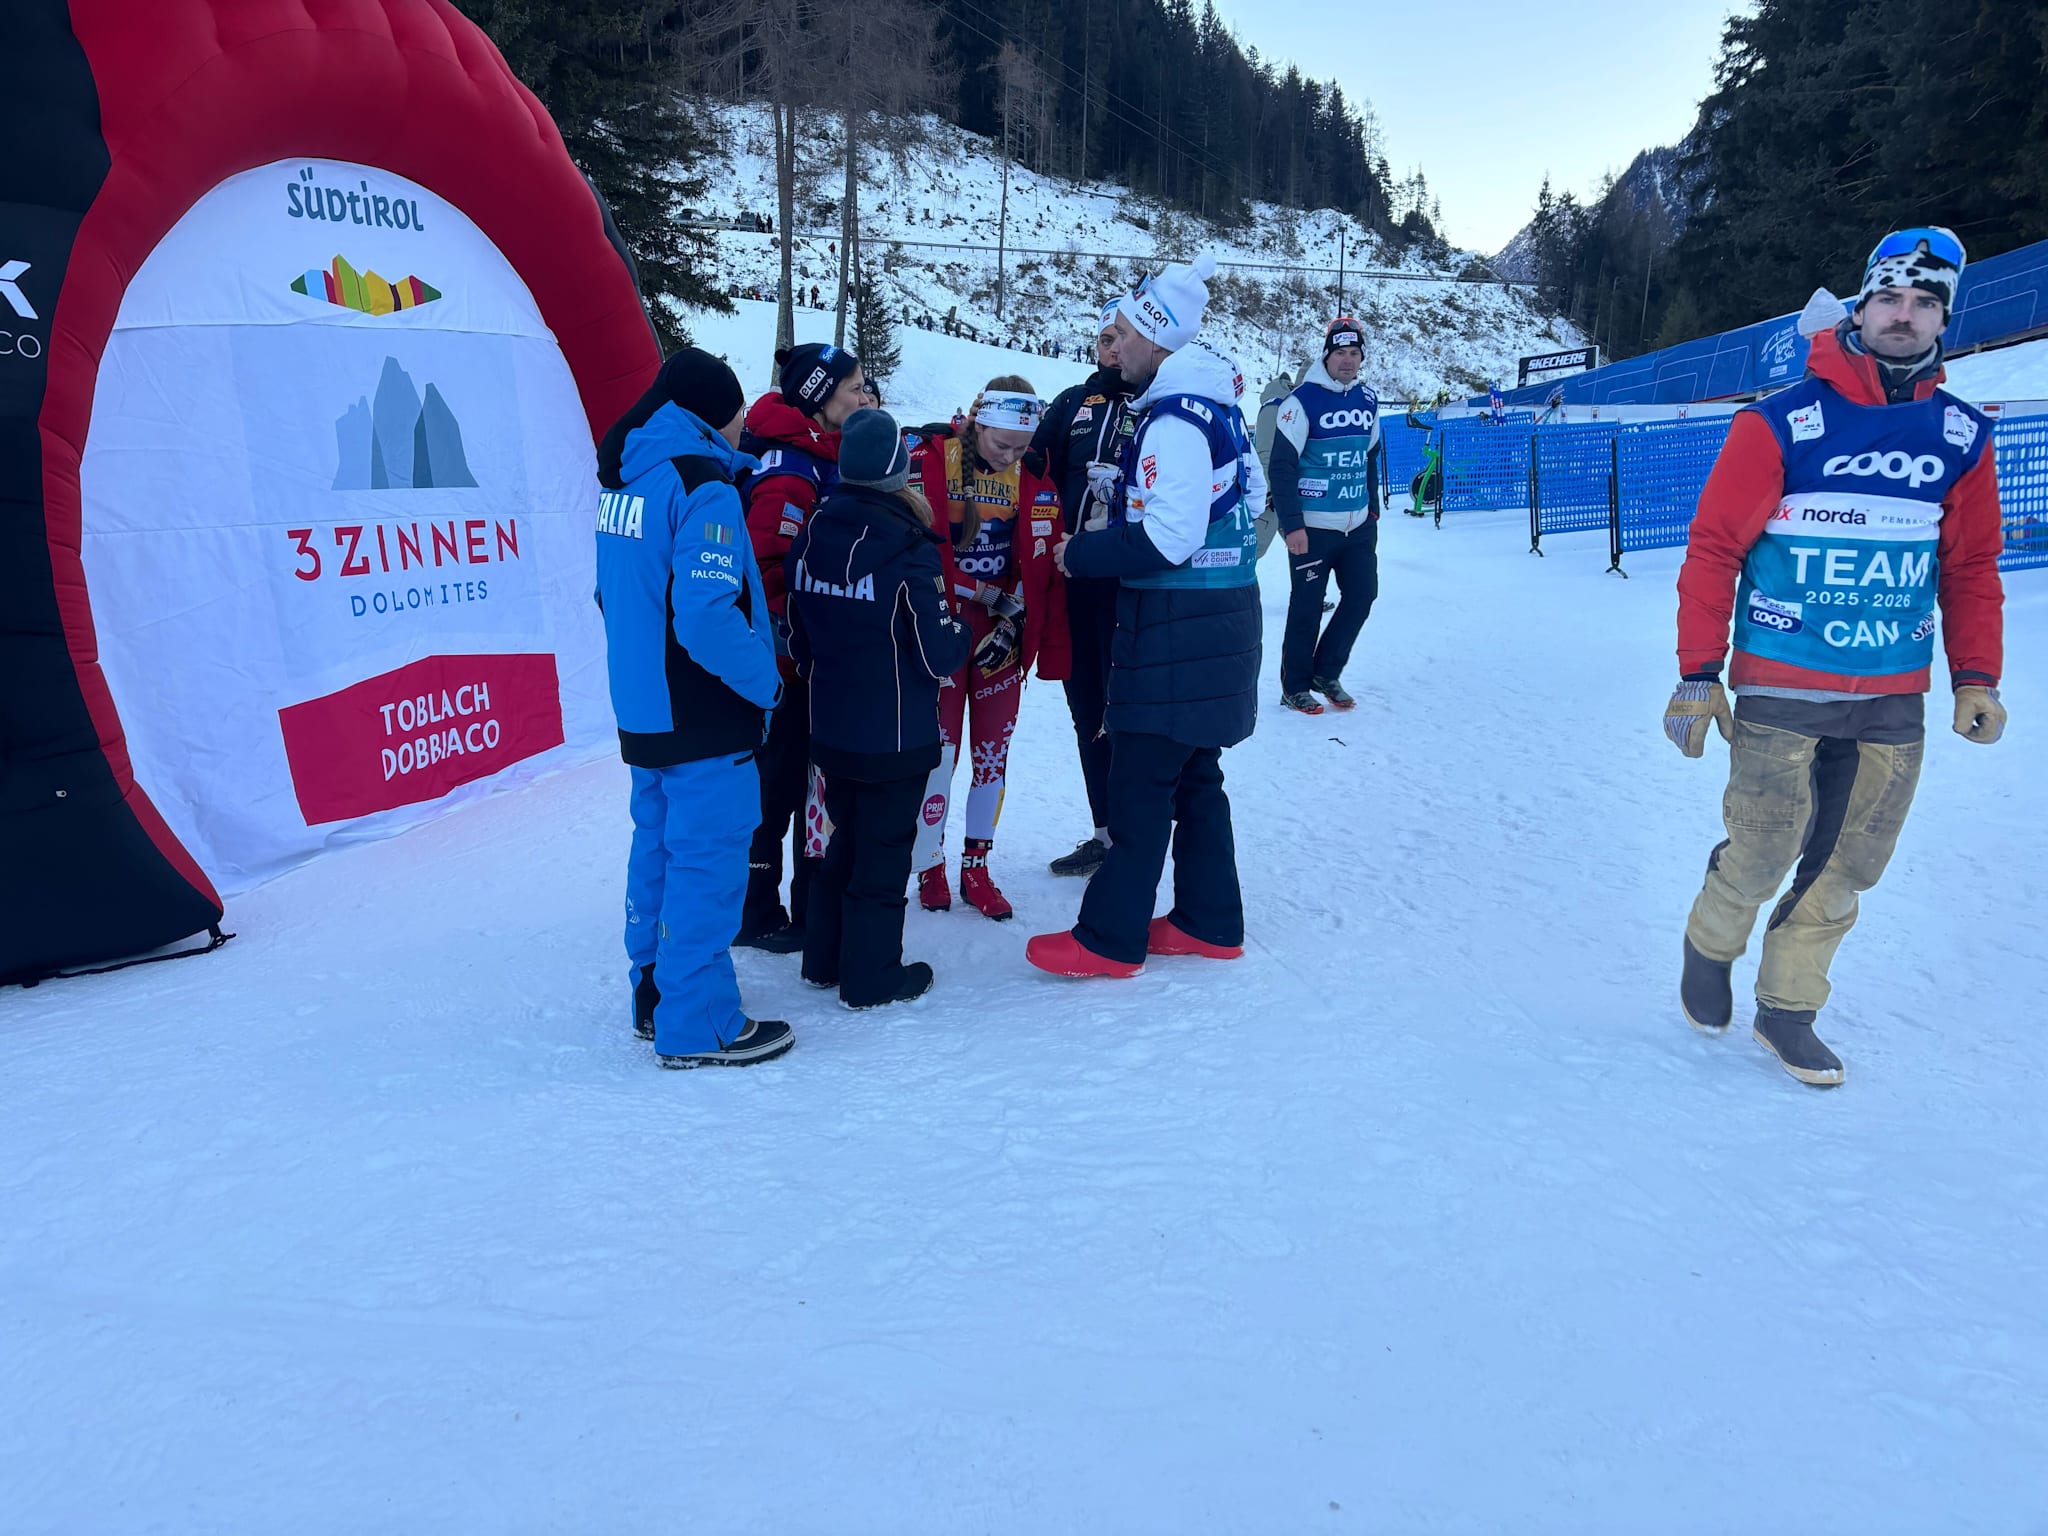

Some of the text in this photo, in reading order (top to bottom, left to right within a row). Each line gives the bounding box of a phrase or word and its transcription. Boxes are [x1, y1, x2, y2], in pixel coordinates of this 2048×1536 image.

[1527, 351, 1588, 370] SKECHERS
[1319, 409, 1373, 430] coop
[1822, 450, 1945, 489] coop
[947, 492, 1009, 506] SWIERLAND
[1301, 490, 1323, 498] coop
[1337, 486, 1365, 499] AUT
[596, 492, 645, 540] TALIA
[1802, 508, 1867, 525] norda
[287, 518, 520, 582] 3 ZINNEN
[700, 551, 734, 569] enel
[1789, 547, 1931, 588] TEAM
[691, 569, 739, 588] FALCONERI
[350, 579, 489, 617] DOLOMITES
[1752, 609, 1794, 630] coop
[1823, 620, 1900, 648] CAN
[974, 673, 1018, 700] CRAFT
[379, 682, 491, 736] TOBLACH
[381, 719, 500, 782] DOBBIACO
[926, 802, 944, 812] PRIX
